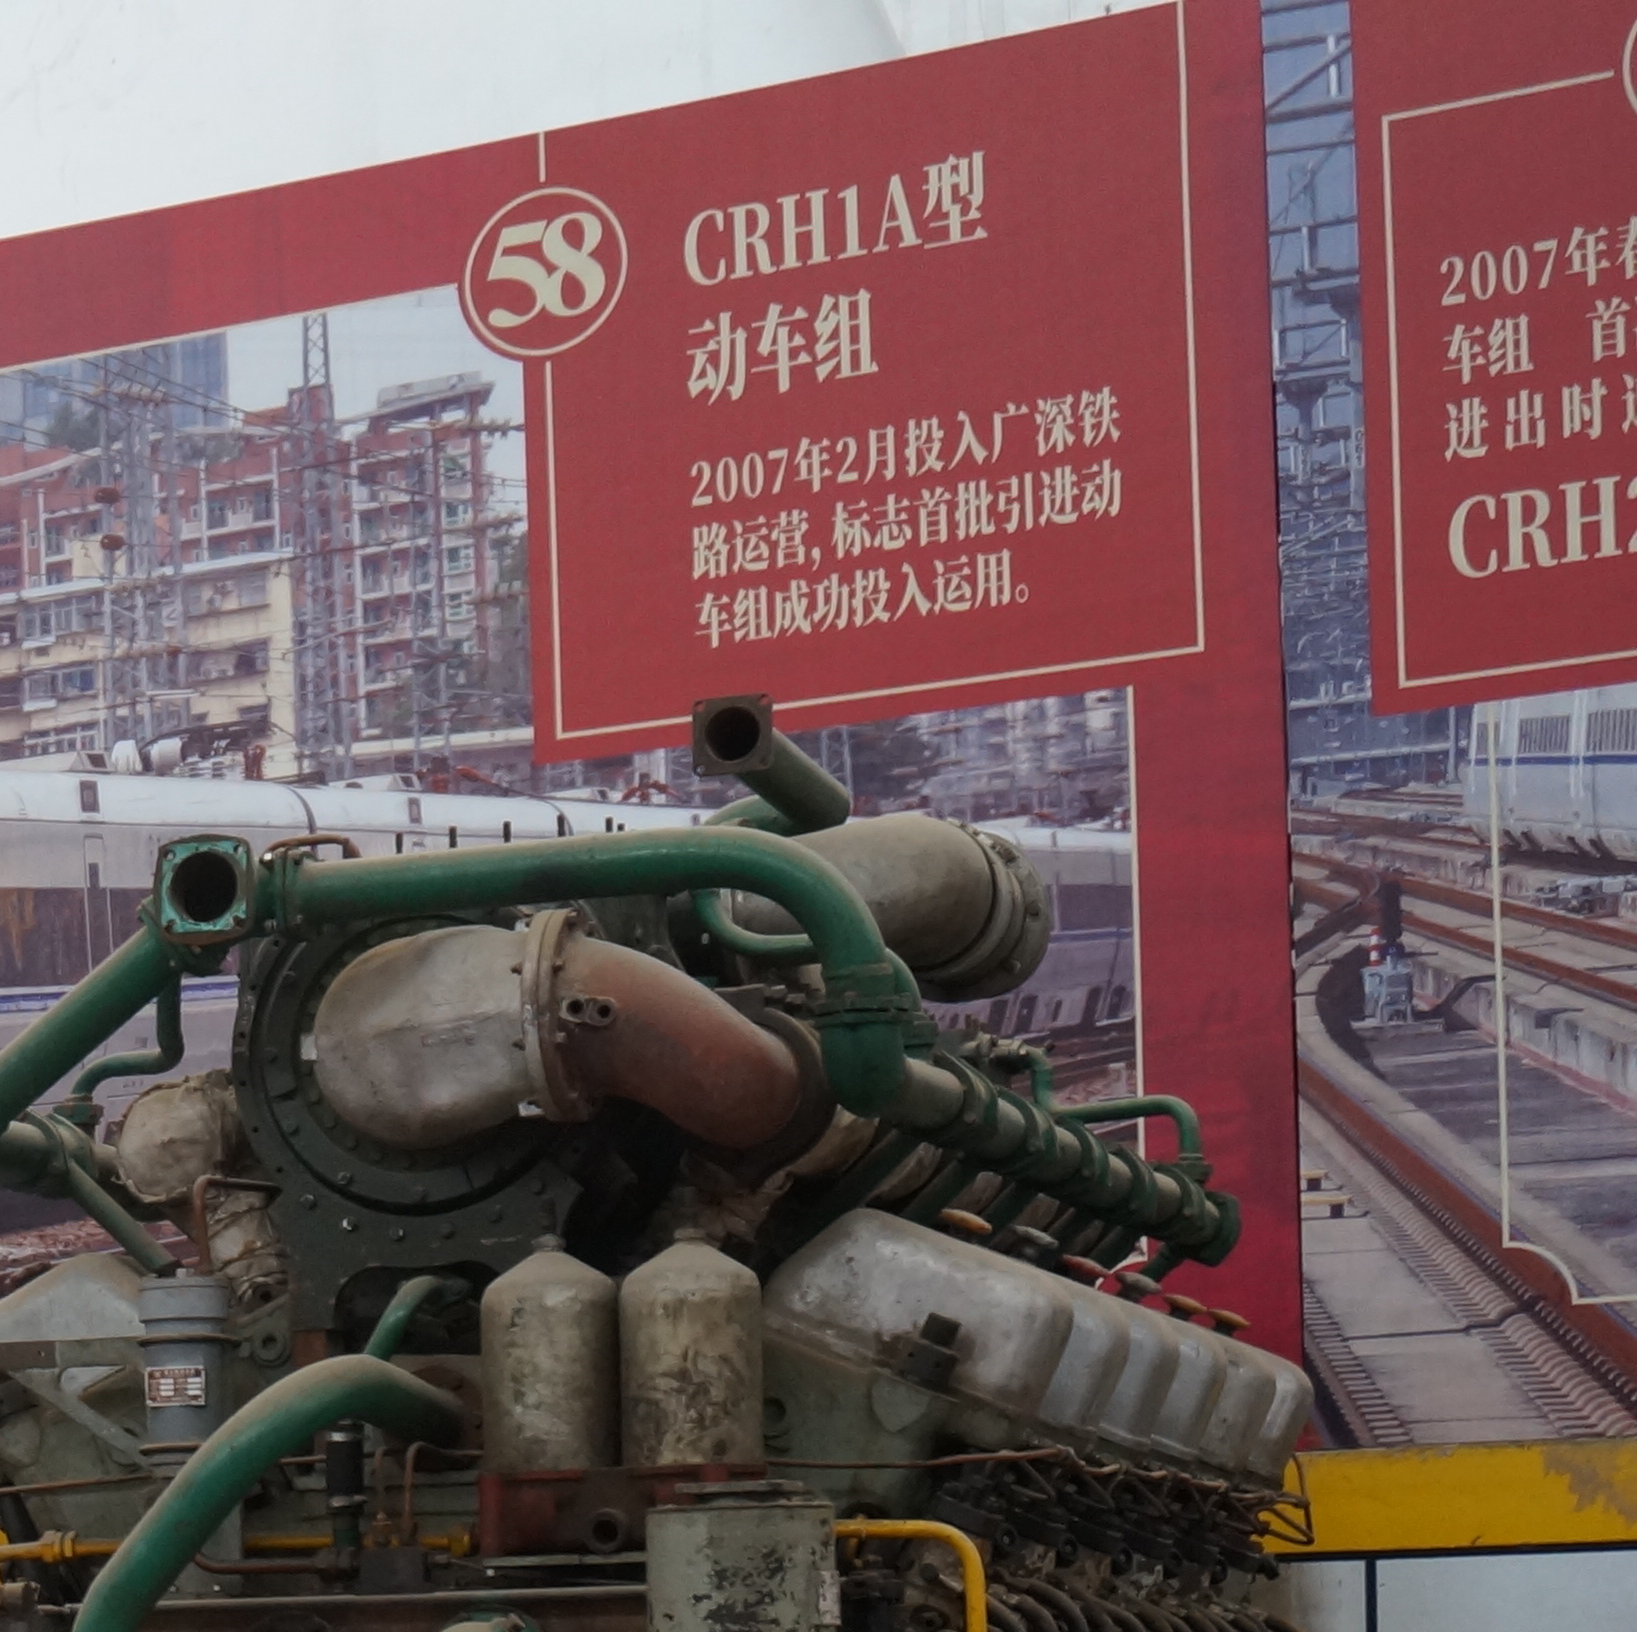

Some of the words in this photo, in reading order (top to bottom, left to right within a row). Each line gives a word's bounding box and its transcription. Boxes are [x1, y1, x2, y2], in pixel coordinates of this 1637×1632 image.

[486, 210, 607, 328] 58
[683, 150, 989, 287] CRH1A型
[685, 287, 880, 407] 动车组
[1442, 314, 1534, 385] 车组
[1585, 296, 1637, 364] 首
[690, 385, 1121, 507] 2007年2月投入广深铁
[1447, 475, 1637, 579] CRH
[693, 547, 1030, 649] 车组成功投入运用。
